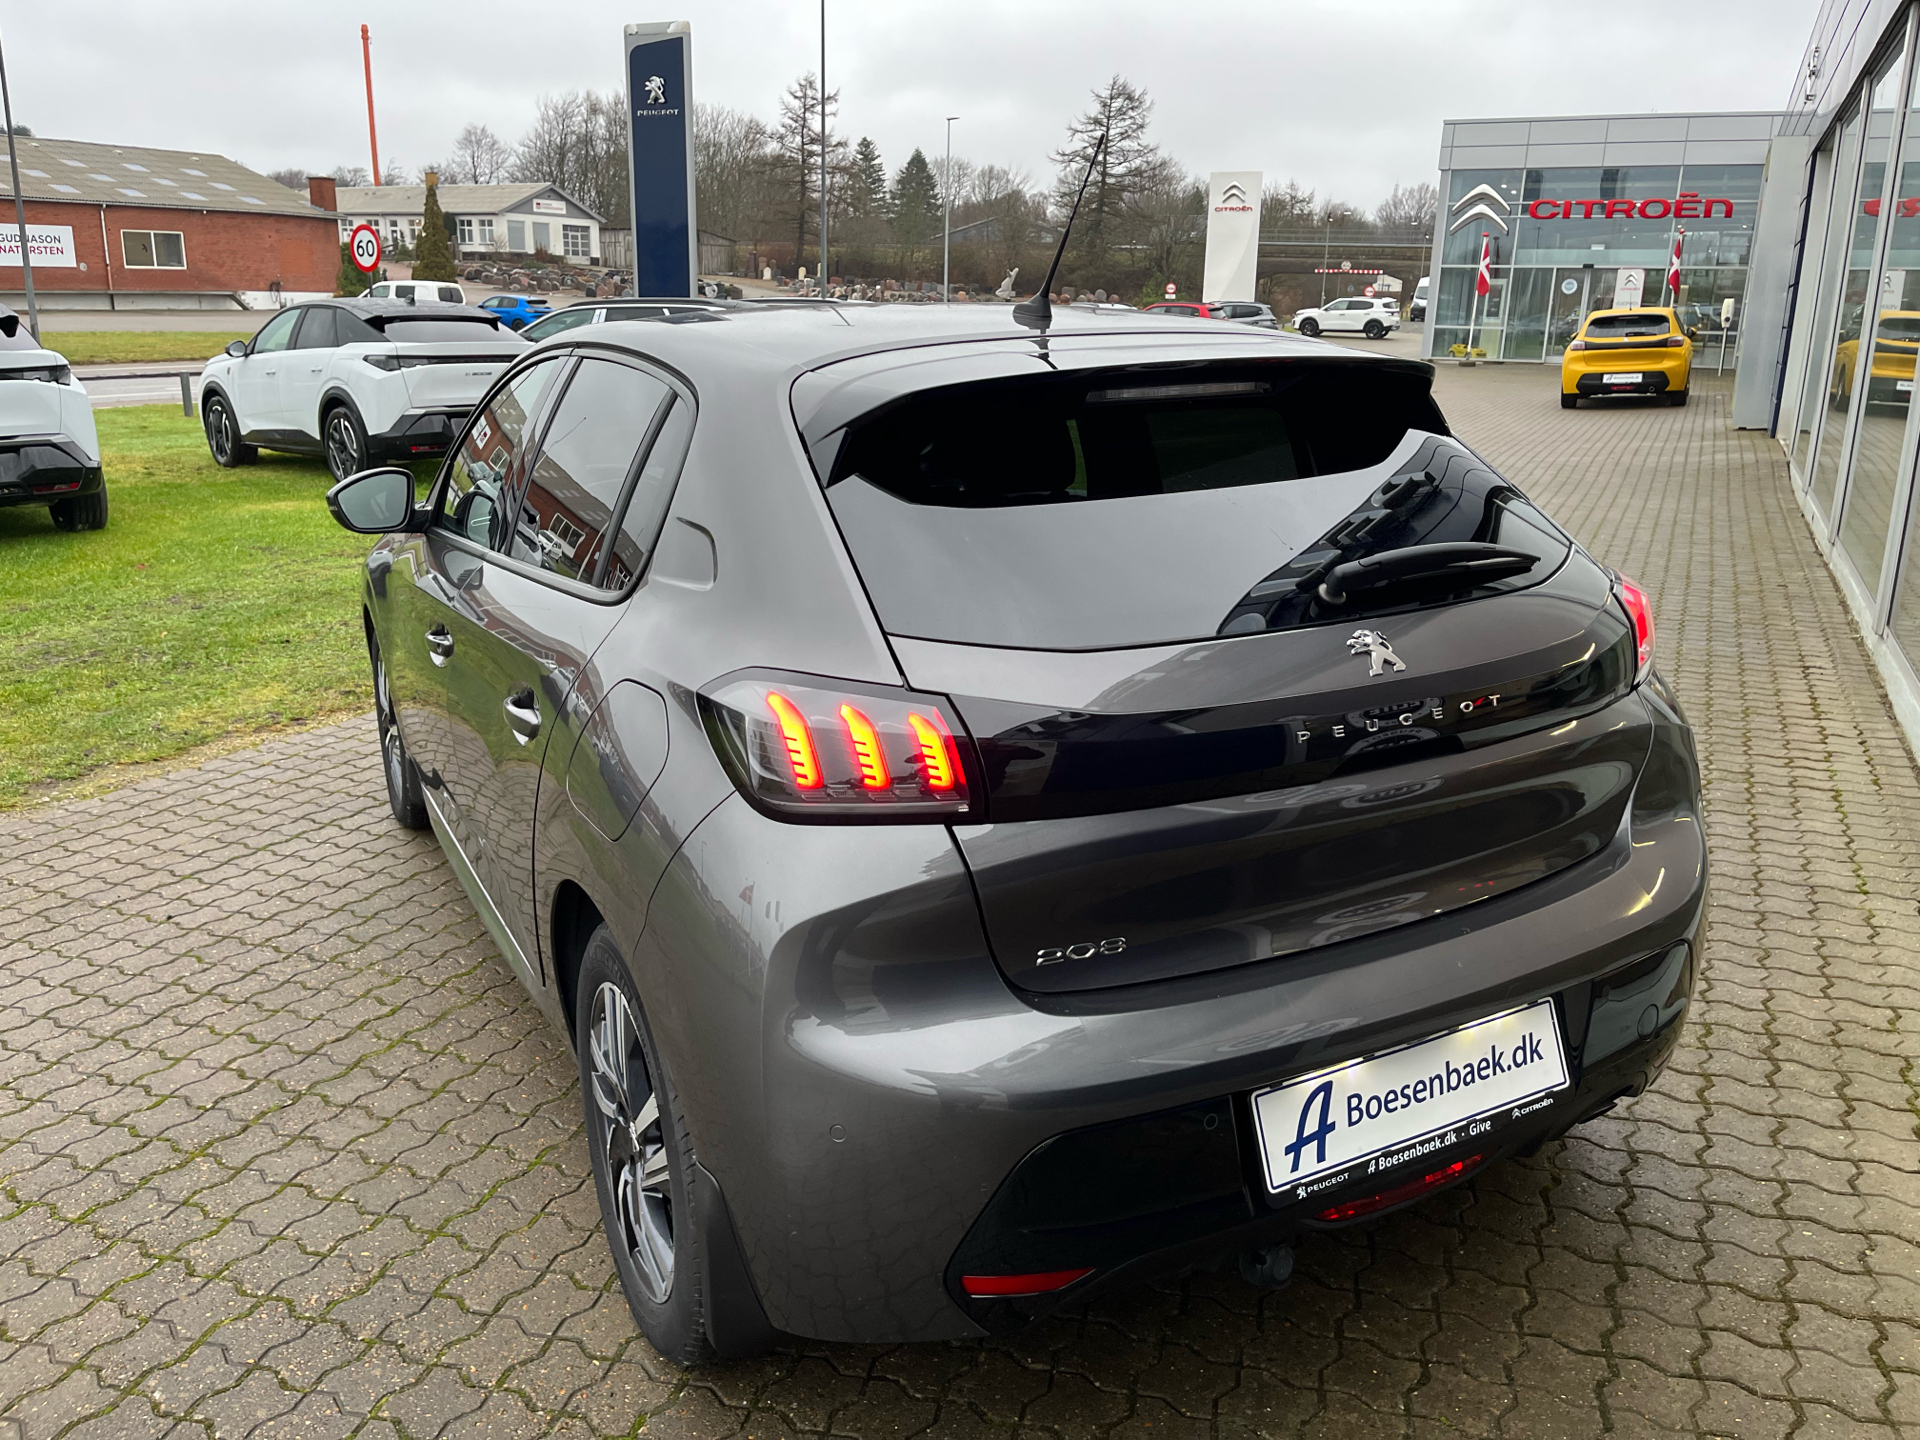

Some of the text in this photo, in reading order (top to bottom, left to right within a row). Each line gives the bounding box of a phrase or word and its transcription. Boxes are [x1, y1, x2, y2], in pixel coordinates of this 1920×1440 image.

[637, 108, 679, 117] PEUGEOT
[1528, 192, 1734, 220] CITROËN
[0, 245, 64, 255] NATRSTEN
[356, 239, 375, 257] 60
[1296, 694, 1500, 744] PEUGEOT
[1035, 937, 1127, 967] 208
[1346, 1031, 1544, 1128] Boesenbaek.dk
[1521, 1097, 1554, 1116] CITROËN
[1378, 1131, 1458, 1172] Boesenbaek.dk
[1469, 1118, 1492, 1136] Give
[1307, 1172, 1350, 1195] PEUGEOT
